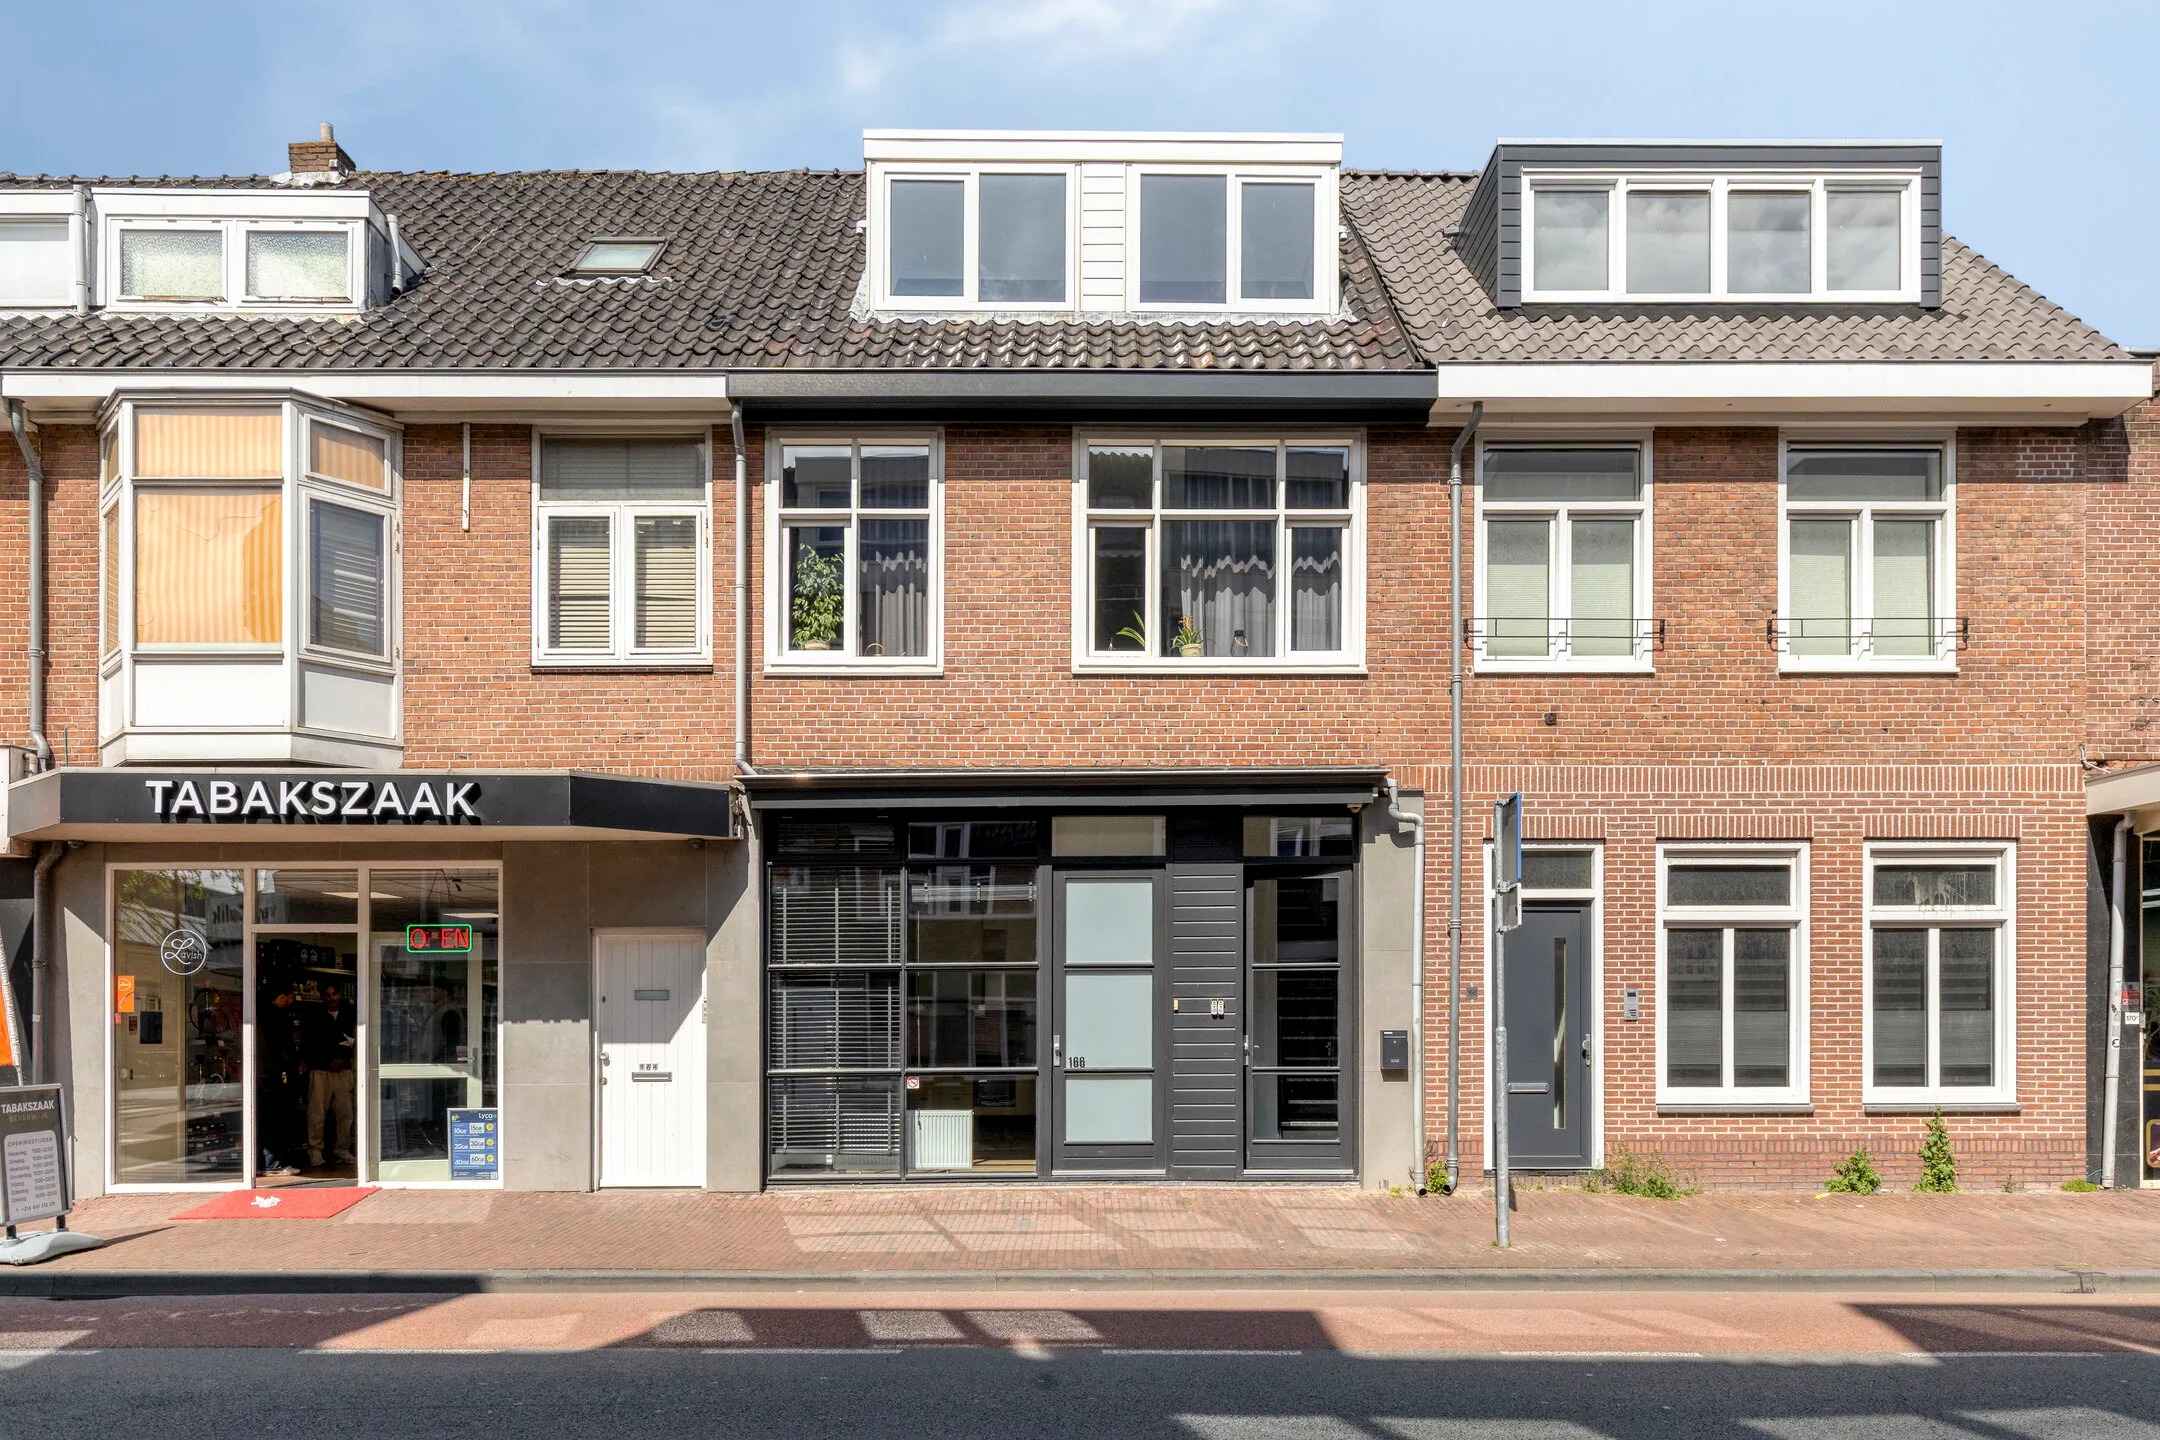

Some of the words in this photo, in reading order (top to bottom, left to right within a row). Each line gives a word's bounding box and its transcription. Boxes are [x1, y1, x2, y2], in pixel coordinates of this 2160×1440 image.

[145, 780, 475, 816] TABAKSZAAK
[164, 938, 203, 965] Lavish
[1068, 1056, 1085, 1068] 166
[1, 1100, 55, 1114] TABAKSZAAK
[478, 1112, 493, 1120] Lyca
[8, 1136, 53, 1147] OPENINGSTIJDEN
